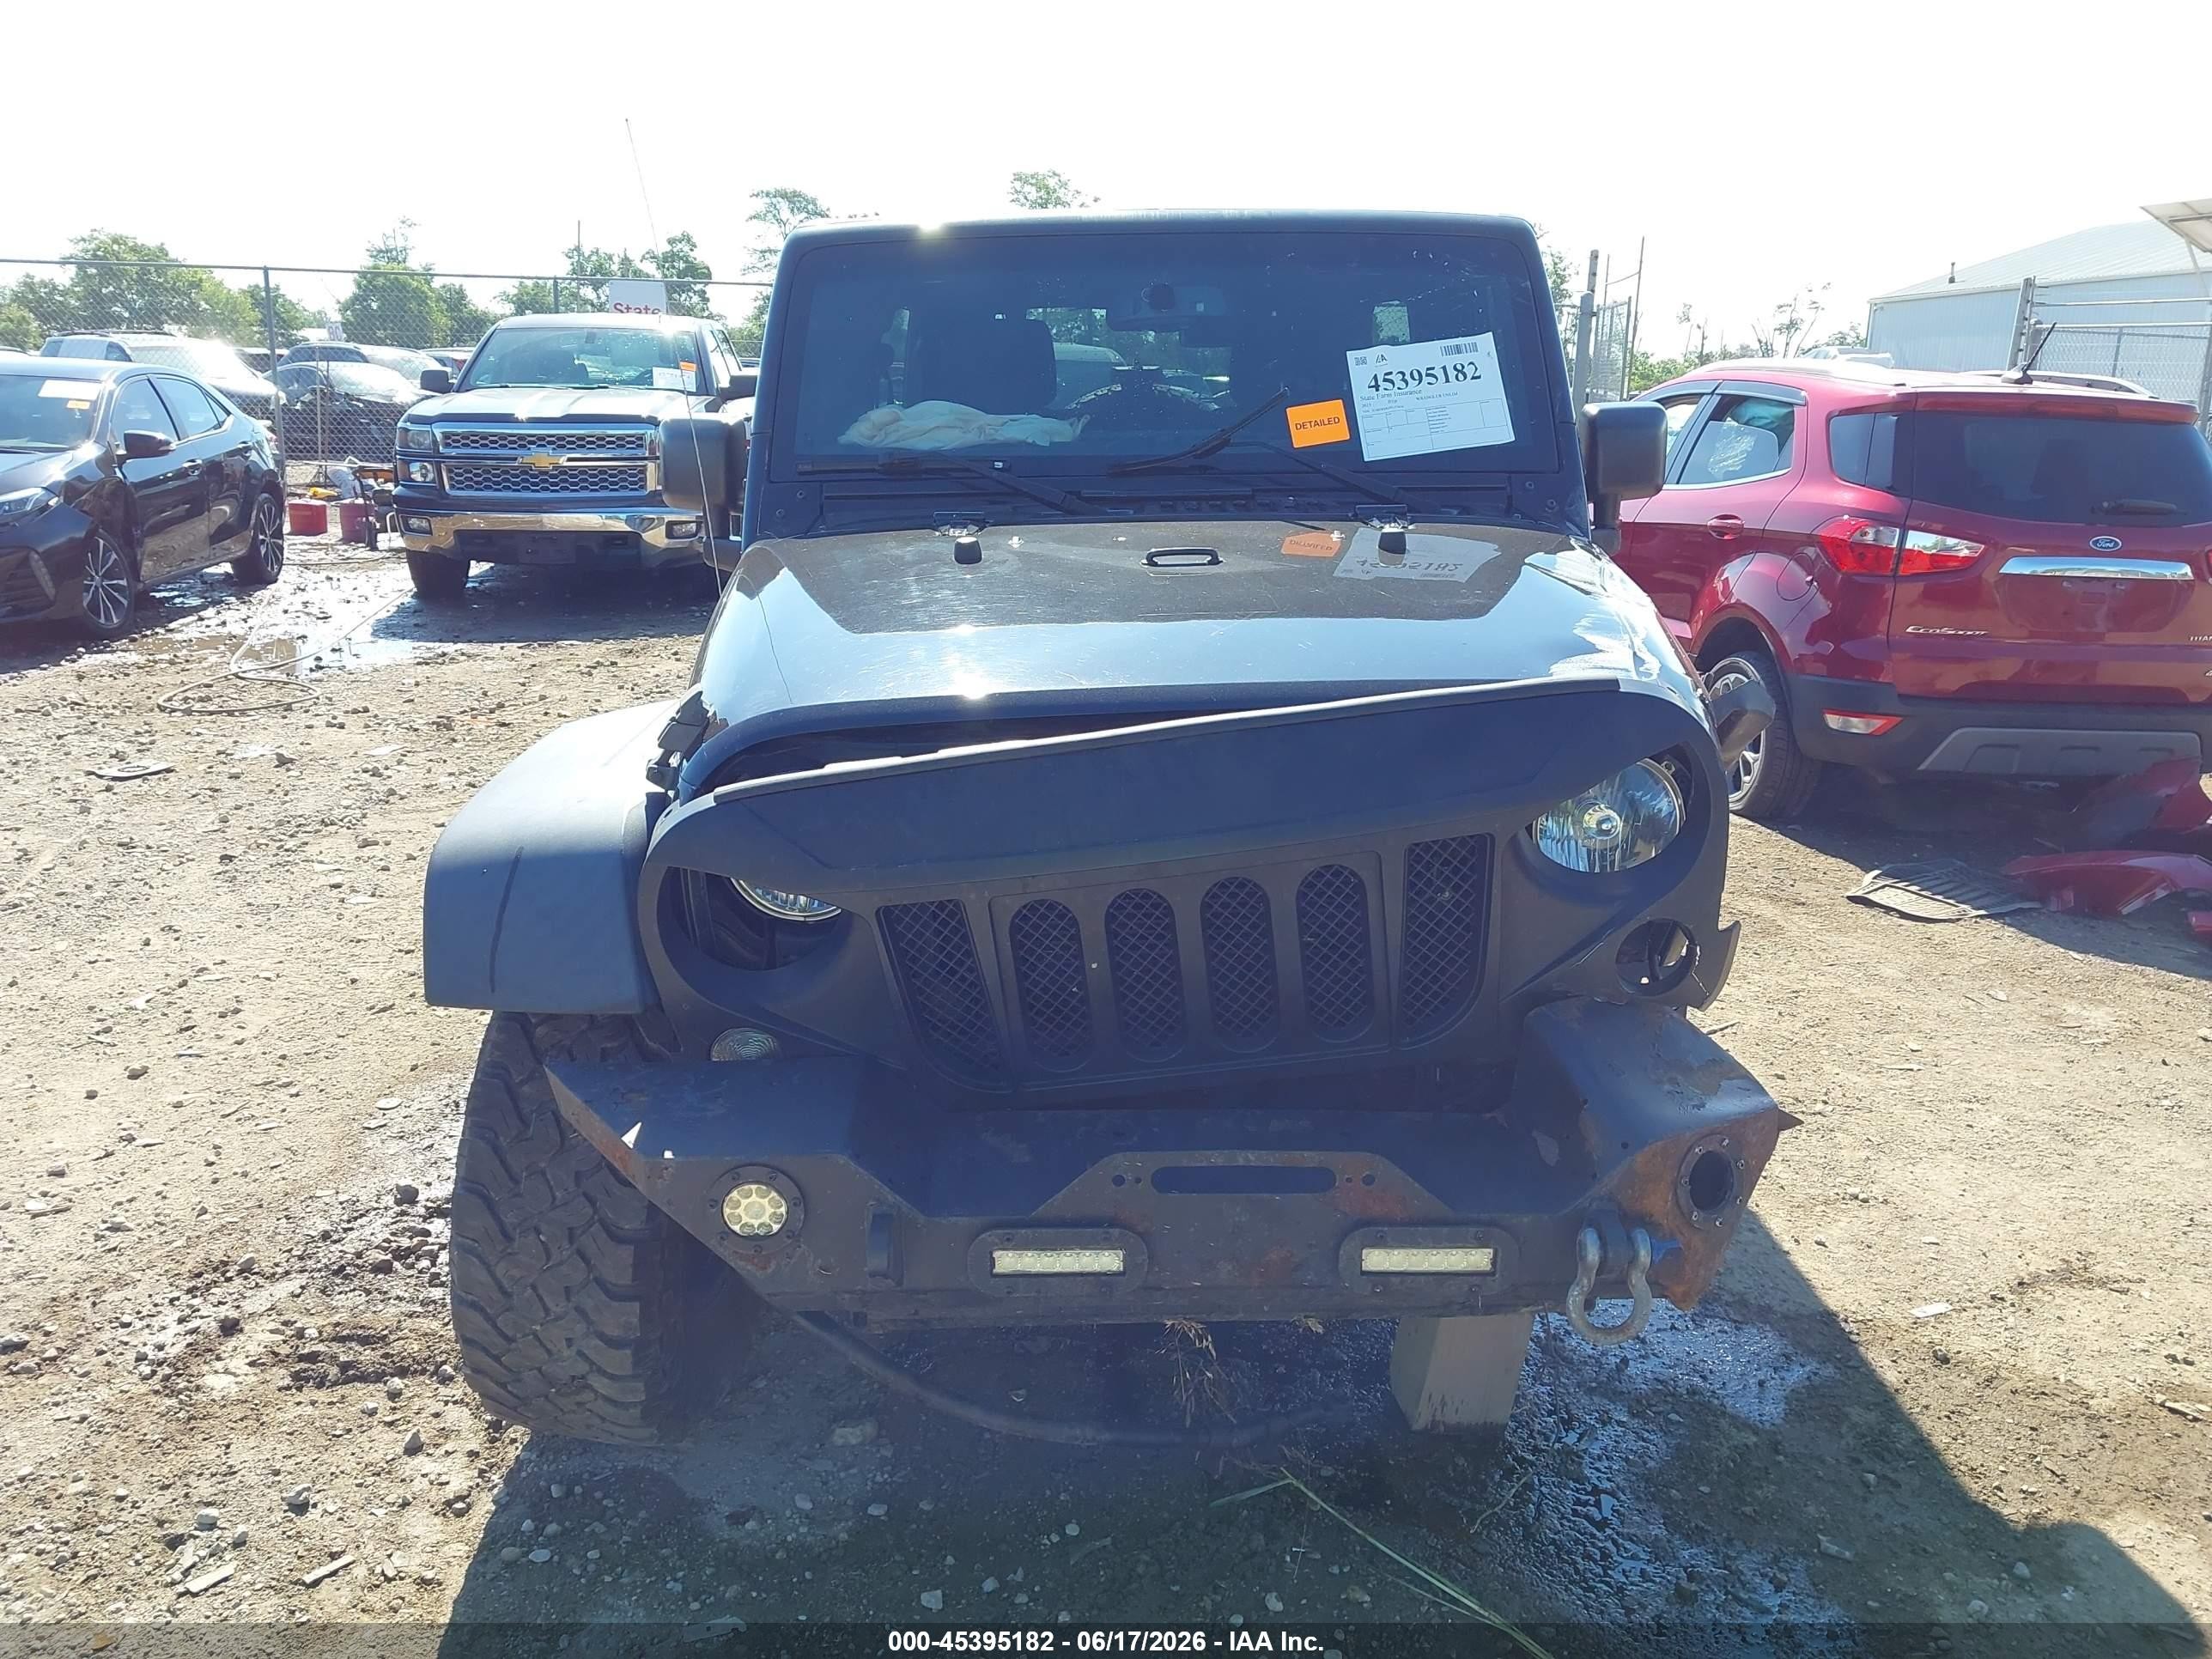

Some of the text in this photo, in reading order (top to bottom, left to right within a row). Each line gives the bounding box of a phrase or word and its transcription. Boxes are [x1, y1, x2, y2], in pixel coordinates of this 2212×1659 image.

[1368, 361, 1481, 392] 45395182
[1395, 389, 1422, 398] Insurance
[1295, 416, 1340, 430] DETAILED
[2096, 538, 2115, 549] Ford
